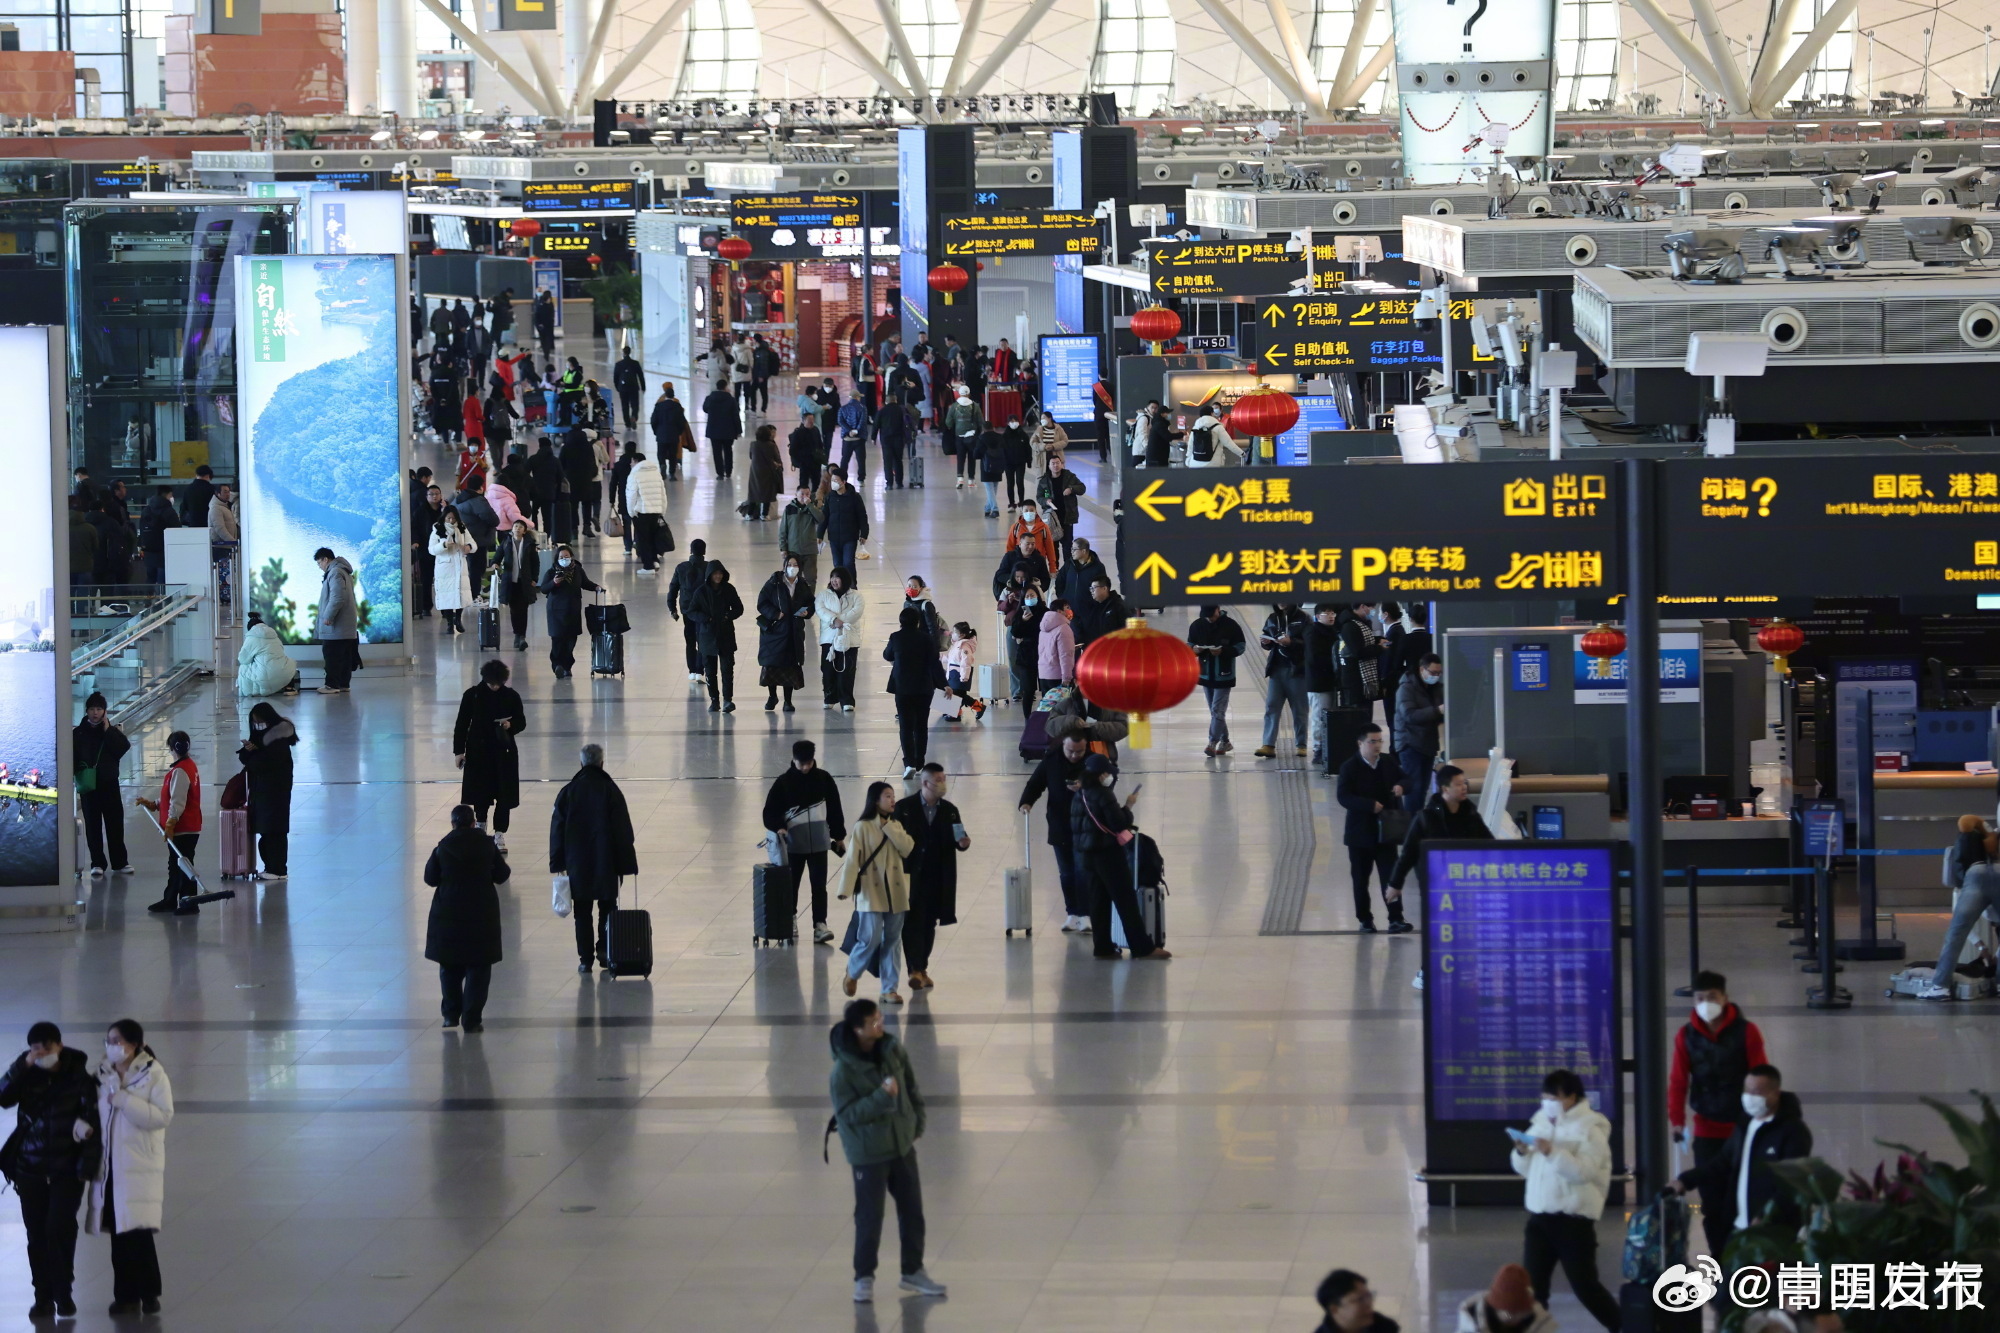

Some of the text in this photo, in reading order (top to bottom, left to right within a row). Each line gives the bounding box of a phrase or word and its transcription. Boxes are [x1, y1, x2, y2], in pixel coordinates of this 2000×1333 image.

[975, 239, 1004, 248] 到达大厅
[1081, 237, 1098, 246] 出口
[1194, 245, 1235, 257] 到达大厅
[1238, 245, 1252, 263] P
[1253, 243, 1284, 256] 停车场
[1253, 255, 1279, 263] Parking
[1174, 275, 1215, 287] 自助值机
[1324, 270, 1345, 282] 出口
[1308, 302, 1338, 318] 问询
[1308, 317, 1342, 327] Enquiry
[1379, 317, 1408, 325] Arrival
[261, 309, 271, 361] 保护生态环境
[1294, 341, 1349, 356] 自助值机
[1371, 340, 1424, 354] 行李打包
[1294, 357, 1354, 366] Self Check-in
[1371, 354, 1444, 365] Baggage Packing
[1239, 478, 1290, 504] 售票
[1552, 473, 1606, 500] 出口
[1701, 478, 1747, 501] 问询
[1239, 509, 1313, 524] Ticketing
[1552, 502, 1597, 517] Exit
[1702, 504, 1749, 518] Enquiry
[1239, 548, 1341, 575] 到达大厅
[1389, 546, 1466, 572] 停车场
[1351, 547, 1387, 592] P
[1241, 578, 1341, 593] Arrival Hall
[1389, 576, 1481, 592] Parking Lot
[1448, 862, 1589, 880] 国内值机柜台分布
[1440, 894, 1454, 912] A
[1440, 924, 1454, 943] B
[1441, 954, 1455, 973] C
